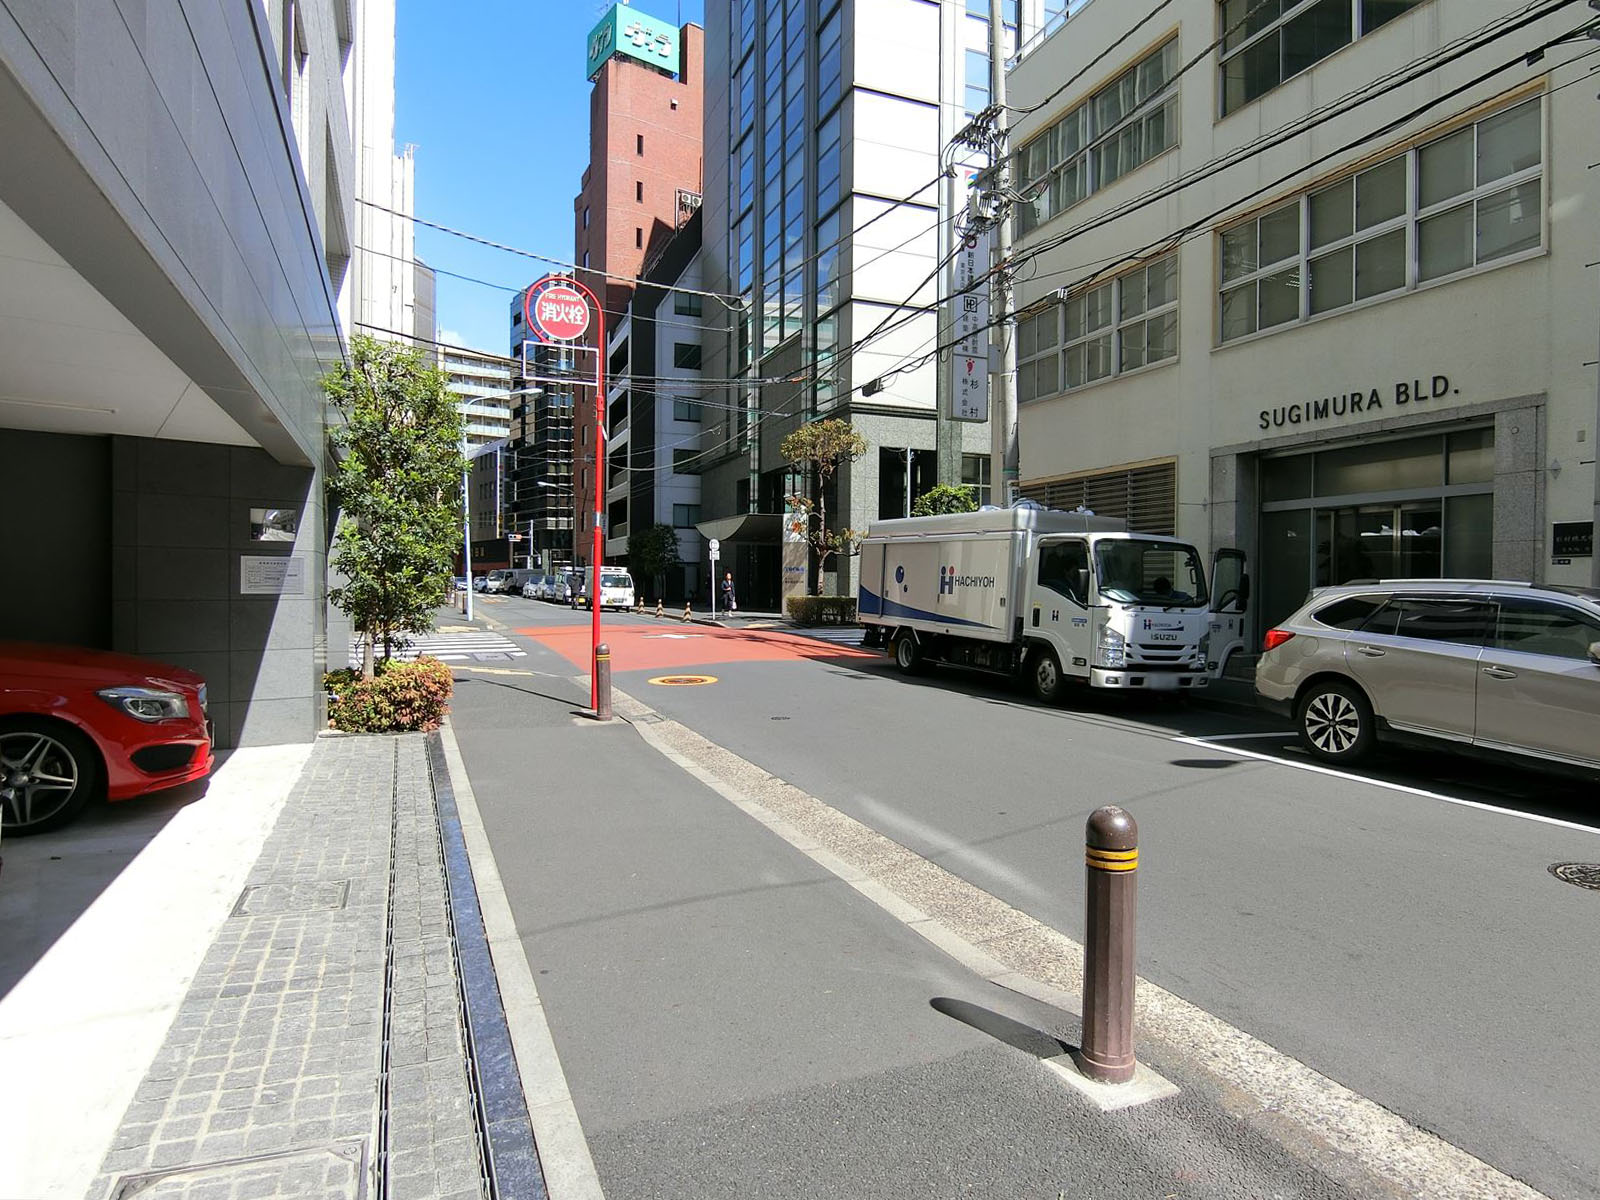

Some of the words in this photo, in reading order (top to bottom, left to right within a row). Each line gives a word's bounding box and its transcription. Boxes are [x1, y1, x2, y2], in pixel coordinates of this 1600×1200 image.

[541, 301, 585, 325] 消火栓
[1259, 388, 1383, 430] SUGIMURA
[1396, 375, 1460, 405] BLD.
[954, 576, 995, 588] HACHIYOH
[1150, 633, 1177, 641] ISUZU
